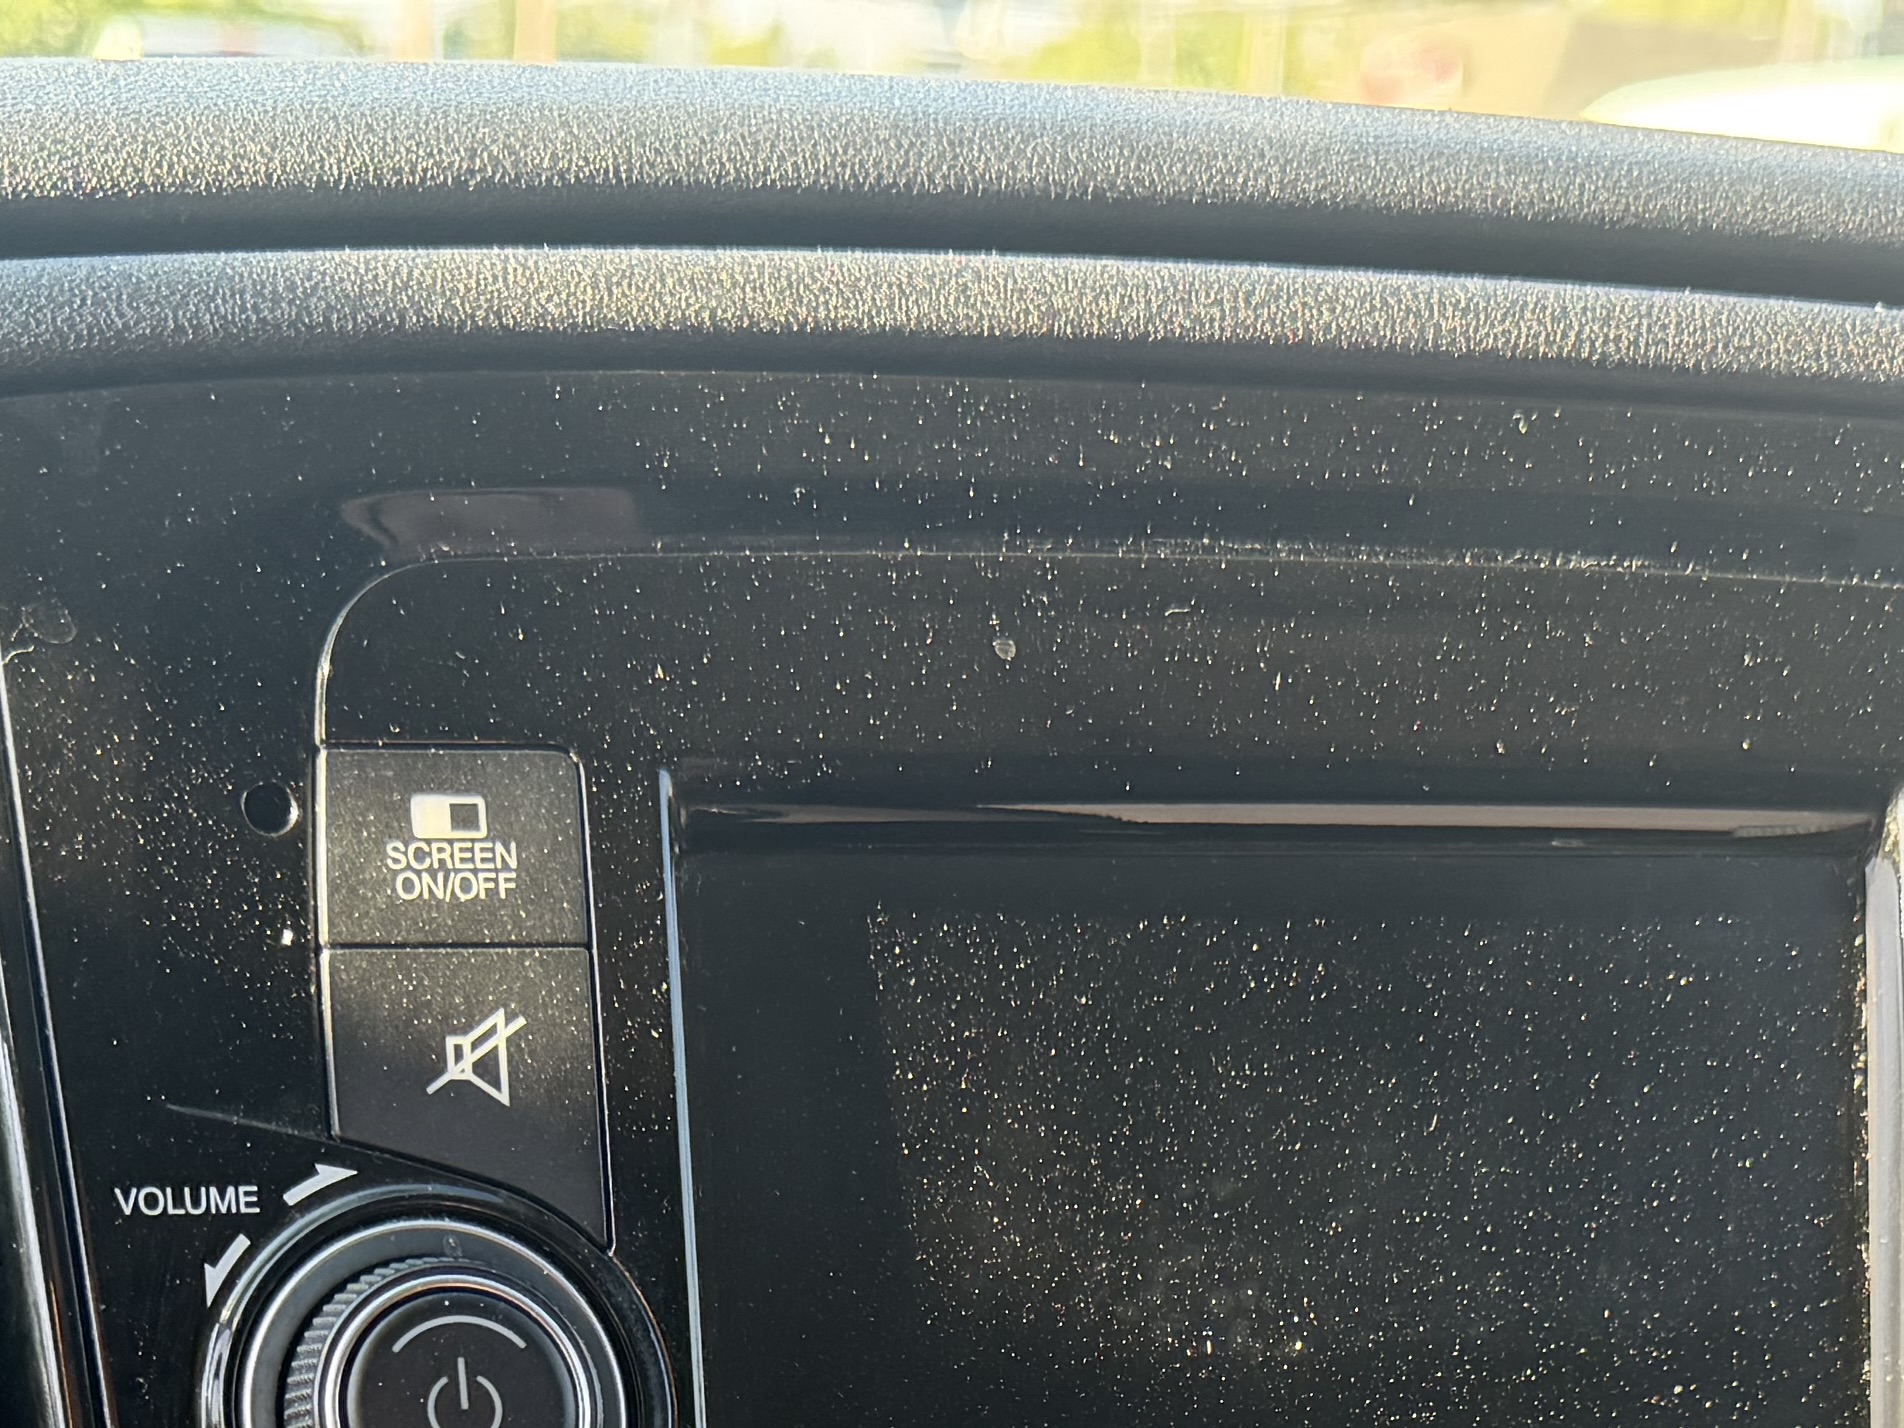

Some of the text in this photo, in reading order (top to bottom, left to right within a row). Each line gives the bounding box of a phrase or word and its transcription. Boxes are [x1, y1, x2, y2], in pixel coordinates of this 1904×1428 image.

[384, 839, 519, 870] SCREEN
[394, 869, 518, 904] ON/OFF
[113, 1183, 262, 1218] VOLUME
